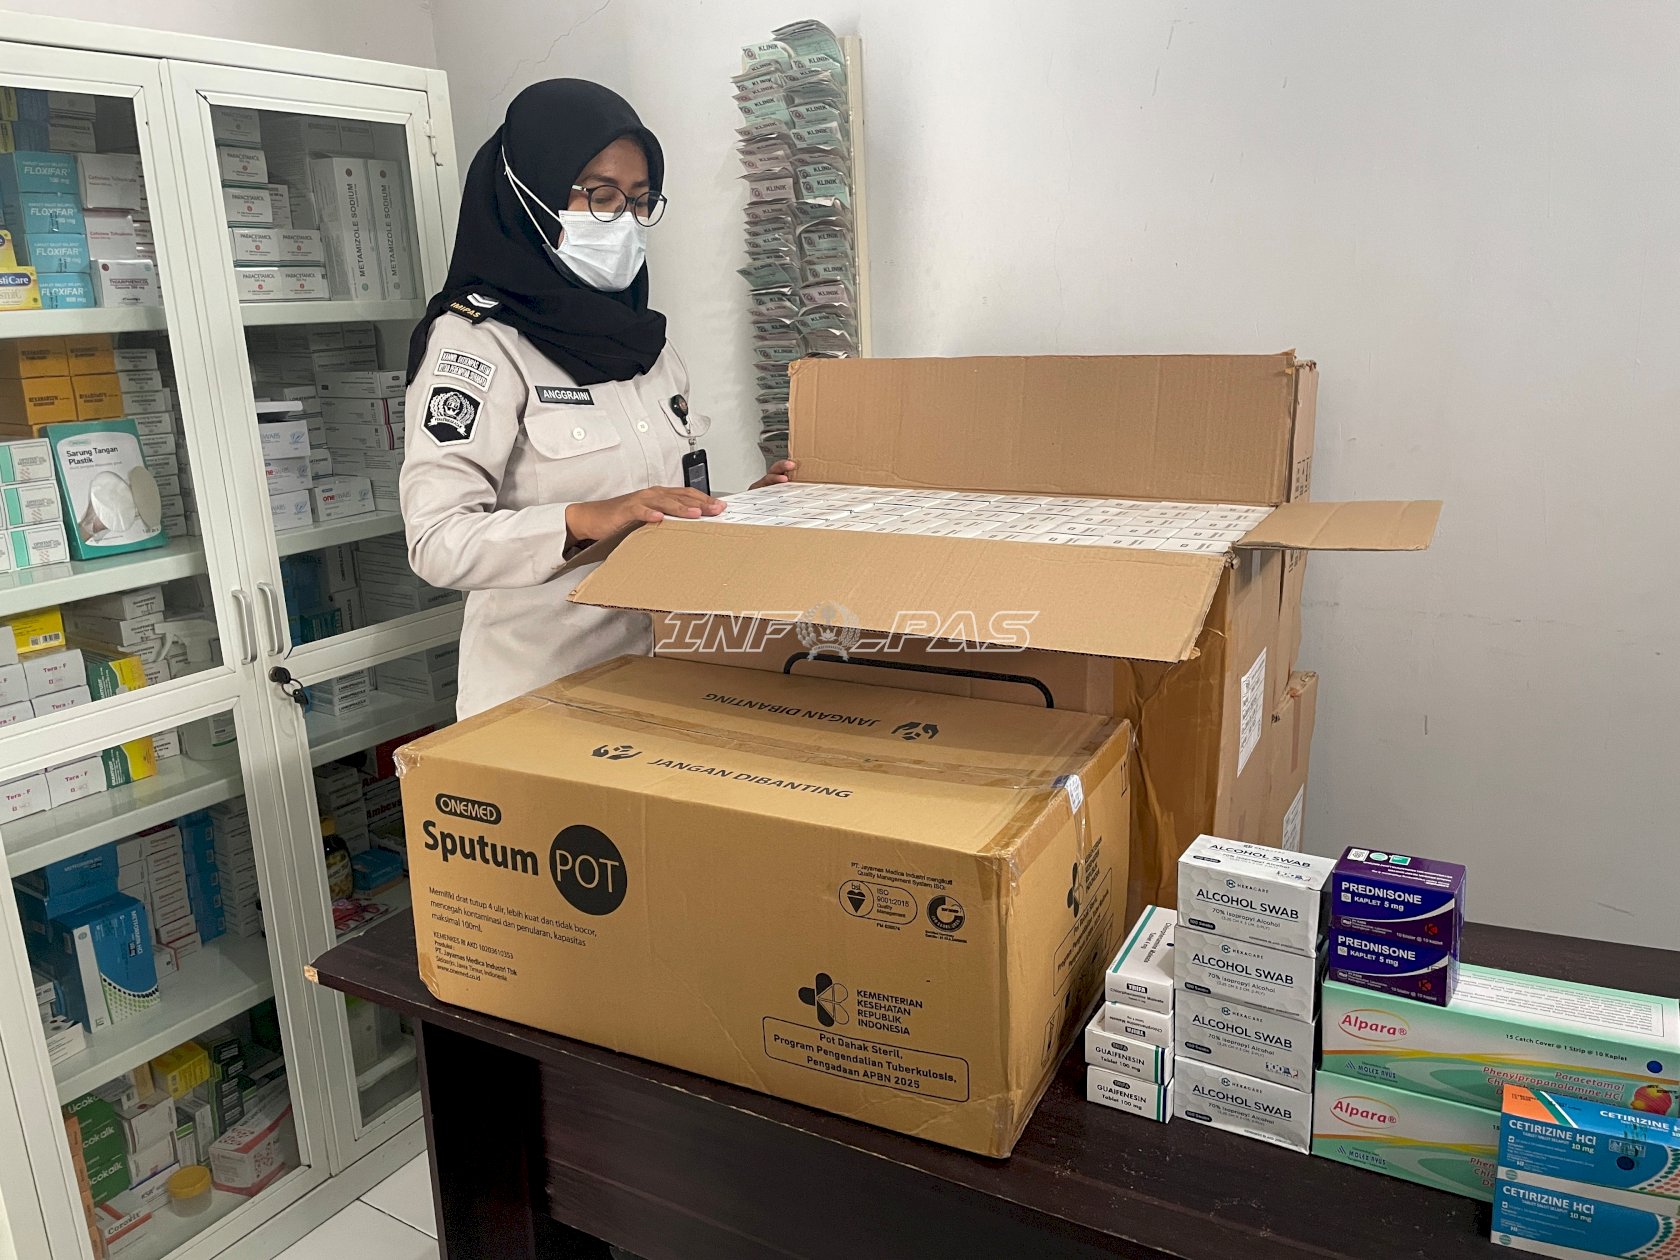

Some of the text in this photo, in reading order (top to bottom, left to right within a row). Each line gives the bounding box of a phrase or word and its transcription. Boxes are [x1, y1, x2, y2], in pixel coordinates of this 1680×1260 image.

[758, 43, 779, 52] KLINIK
[754, 98, 775, 107] KLINIK
[765, 184, 787, 192] KLINIK
[347, 183, 366, 277] METAMIZOLE SODIUM
[381, 185, 397, 276] METAMIZOLE SODIUM
[36, 247, 79, 255] FLOXIFAR
[450, 301, 481, 318] IMIPAS
[543, 389, 590, 401] ANGGRAINI
[66, 446, 118, 458] Sarung Tangan
[68, 457, 94, 465] Plastik
[322, 494, 335, 502] one
[704, 692, 881, 727] JANGAN DIBANTING
[647, 758, 854, 799] JANGAN DIBANTING
[440, 797, 497, 821] ONEMED
[422, 820, 539, 876] Sputum
[1209, 844, 1311, 868] ALCOHOL SWAB
[555, 850, 620, 893] POT
[857, 870, 876, 879] Quality
[876, 873, 911, 885] Management
[912, 879, 933, 889] System
[876, 888, 889, 896] ISO
[1237, 883, 1269, 894] HEXACARE
[1341, 881, 1422, 905] PREDNISONE
[429, 886, 455, 900] Memiliki
[455, 894, 468, 903] drat
[470, 898, 487, 909] tutup
[494, 904, 506, 915] ulir,
[507, 906, 524, 919] lebih
[525, 912, 540, 923] kuat
[541, 916, 554, 926] dan
[555, 920, 574, 931] tidak
[574, 923, 597, 937] bocor,
[876, 895, 909, 908] 9001:2015
[877, 903, 893, 911] Quality
[1196, 888, 1299, 920] ALCOHOL SWAB
[1354, 895, 1381, 907] KAPLET
[1390, 903, 1404, 912] mg
[430, 900, 587, 947] mencegah kontaminasi dan penularan, kapasitas
[431, 912, 461, 927] maksimal
[1212, 907, 1225, 915] 70%
[1226, 911, 1255, 922] Isopropyl
[1256, 918, 1281, 928] Alcohol
[433, 931, 461, 945] KEMENKES
[467, 941, 478, 950] AKD
[1337, 935, 1416, 961] PREDNISONE
[466, 955, 485, 967] Medica
[1232, 949, 1264, 960] HEXACARE
[1350, 949, 1399, 967] KAPLET 5 mg
[1192, 953, 1294, 985] ALCOHOL SWAB
[1208, 972, 1221, 980] 70%
[1222, 976, 1250, 987] Isopropyl
[1251, 983, 1276, 993] Alcohol
[856, 989, 923, 1009] KEMENTERIAN
[857, 999, 911, 1016] KESEHATAN
[857, 1009, 902, 1025] REPUBLIK
[858, 1019, 910, 1036] INDONESIA
[1192, 1014, 1292, 1049] ALCOHOL SWAB
[773, 1034, 814, 1052] Program
[816, 1043, 883, 1069] Pengendalian
[819, 1033, 836, 1045] Pot
[838, 1038, 869, 1052] Dahak
[1515, 1035, 1534, 1045] Catch
[1535, 1038, 1555, 1048] Cover
[1569, 1045, 1586, 1055] Strip
[1604, 1053, 1628, 1062] Kaplet
[1095, 1046, 1145, 1066] GUAIFENESIN
[1100, 1056, 1119, 1067] Tablet
[1131, 1065, 1141, 1073] mg
[806, 1056, 920, 1089] Pengadaan APBN 2025
[1555, 1071, 1625, 1091] Paracetamol
[1483, 1066, 1601, 1096] Phenylpropanolamine
[1605, 1091, 1624, 1101] HCl
[1096, 1084, 1147, 1104] GUAIFENESIN
[1102, 1093, 1120, 1104] Tablet
[1120, 1099, 1131, 1107] 100
[1192, 1084, 1292, 1119] ALCOHOL SWAB
[1600, 1110, 1670, 1130] CETIRIZINE
[1508, 1119, 1596, 1146] CETIRIZINE HCl
[1582, 1146, 1595, 1154] mg
[1502, 1185, 1595, 1215] CETIRIZINE HCl
[1579, 1215, 1592, 1223] mg
